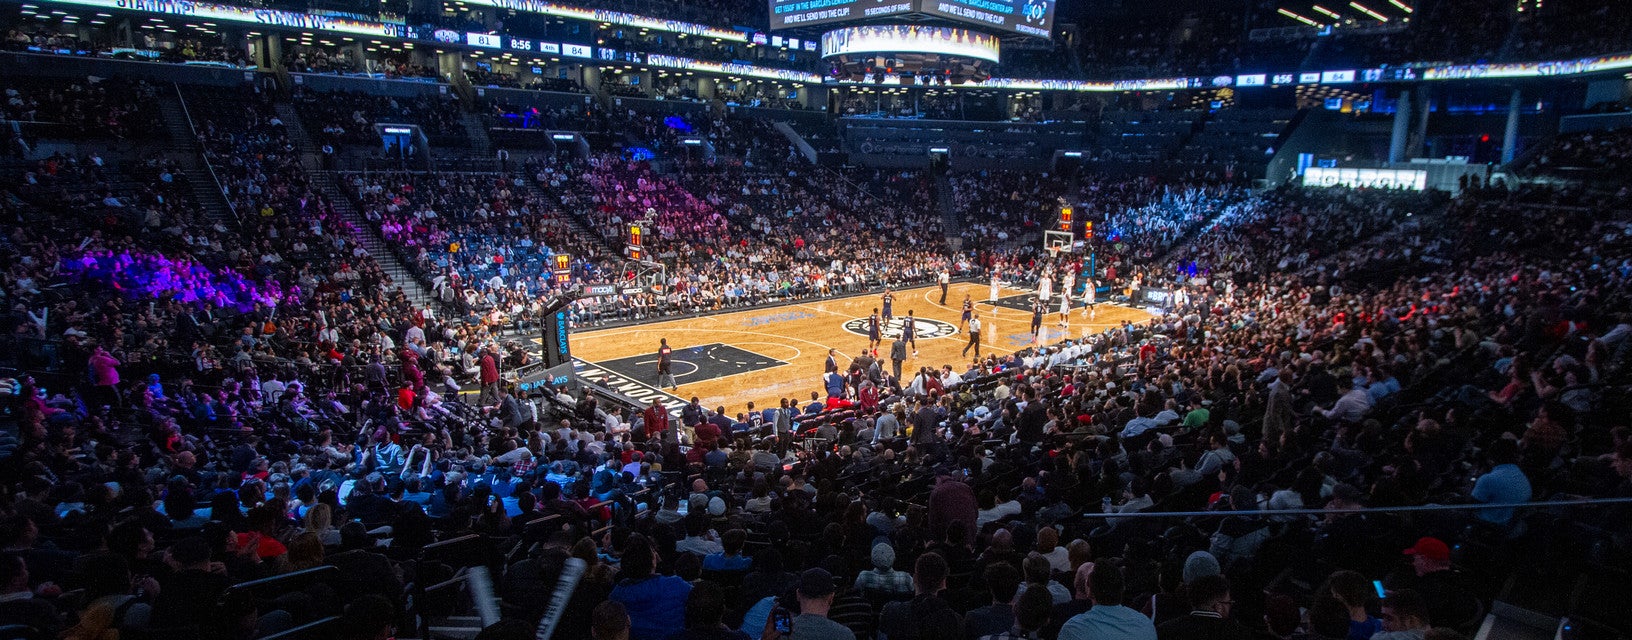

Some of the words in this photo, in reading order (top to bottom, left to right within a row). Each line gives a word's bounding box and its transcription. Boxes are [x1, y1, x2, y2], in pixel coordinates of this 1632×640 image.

[810, 0, 831, 8] BARCLAYS
[870, 6, 890, 15] SECONDS
[890, 4, 898, 12] OF
[898, 2, 910, 11] FAME
[990, 2, 1005, 12] CENTER
[1004, 6, 1014, 14] APP
[255, 9, 304, 27] STAND
[594, 9, 620, 23] STAND
[784, 15, 794, 24] AND
[794, 13, 805, 22] WE'LL
[806, 12, 818, 20] SEND
[818, 10, 828, 19] YOU
[828, 9, 837, 18] THE
[838, 7, 850, 16] CLIP!
[938, 2, 950, 12] AND
[949, 5, 962, 16] WE'LL
[963, 8, 976, 18] SEND
[976, 10, 984, 20] YOU
[984, 12, 993, 22] THE
[666, 20, 693, 33] STAND
[478, 36, 490, 45] 81
[511, 39, 531, 50] 8:56
[572, 47, 582, 55] 84
[650, 54, 677, 68] STAND
[722, 62, 741, 74] STAND
[778, 70, 800, 80] STAND
[1272, 74, 1293, 84] 8:56
[1042, 80, 1068, 90] STAND
[558, 320, 568, 354] BARCLAYS
